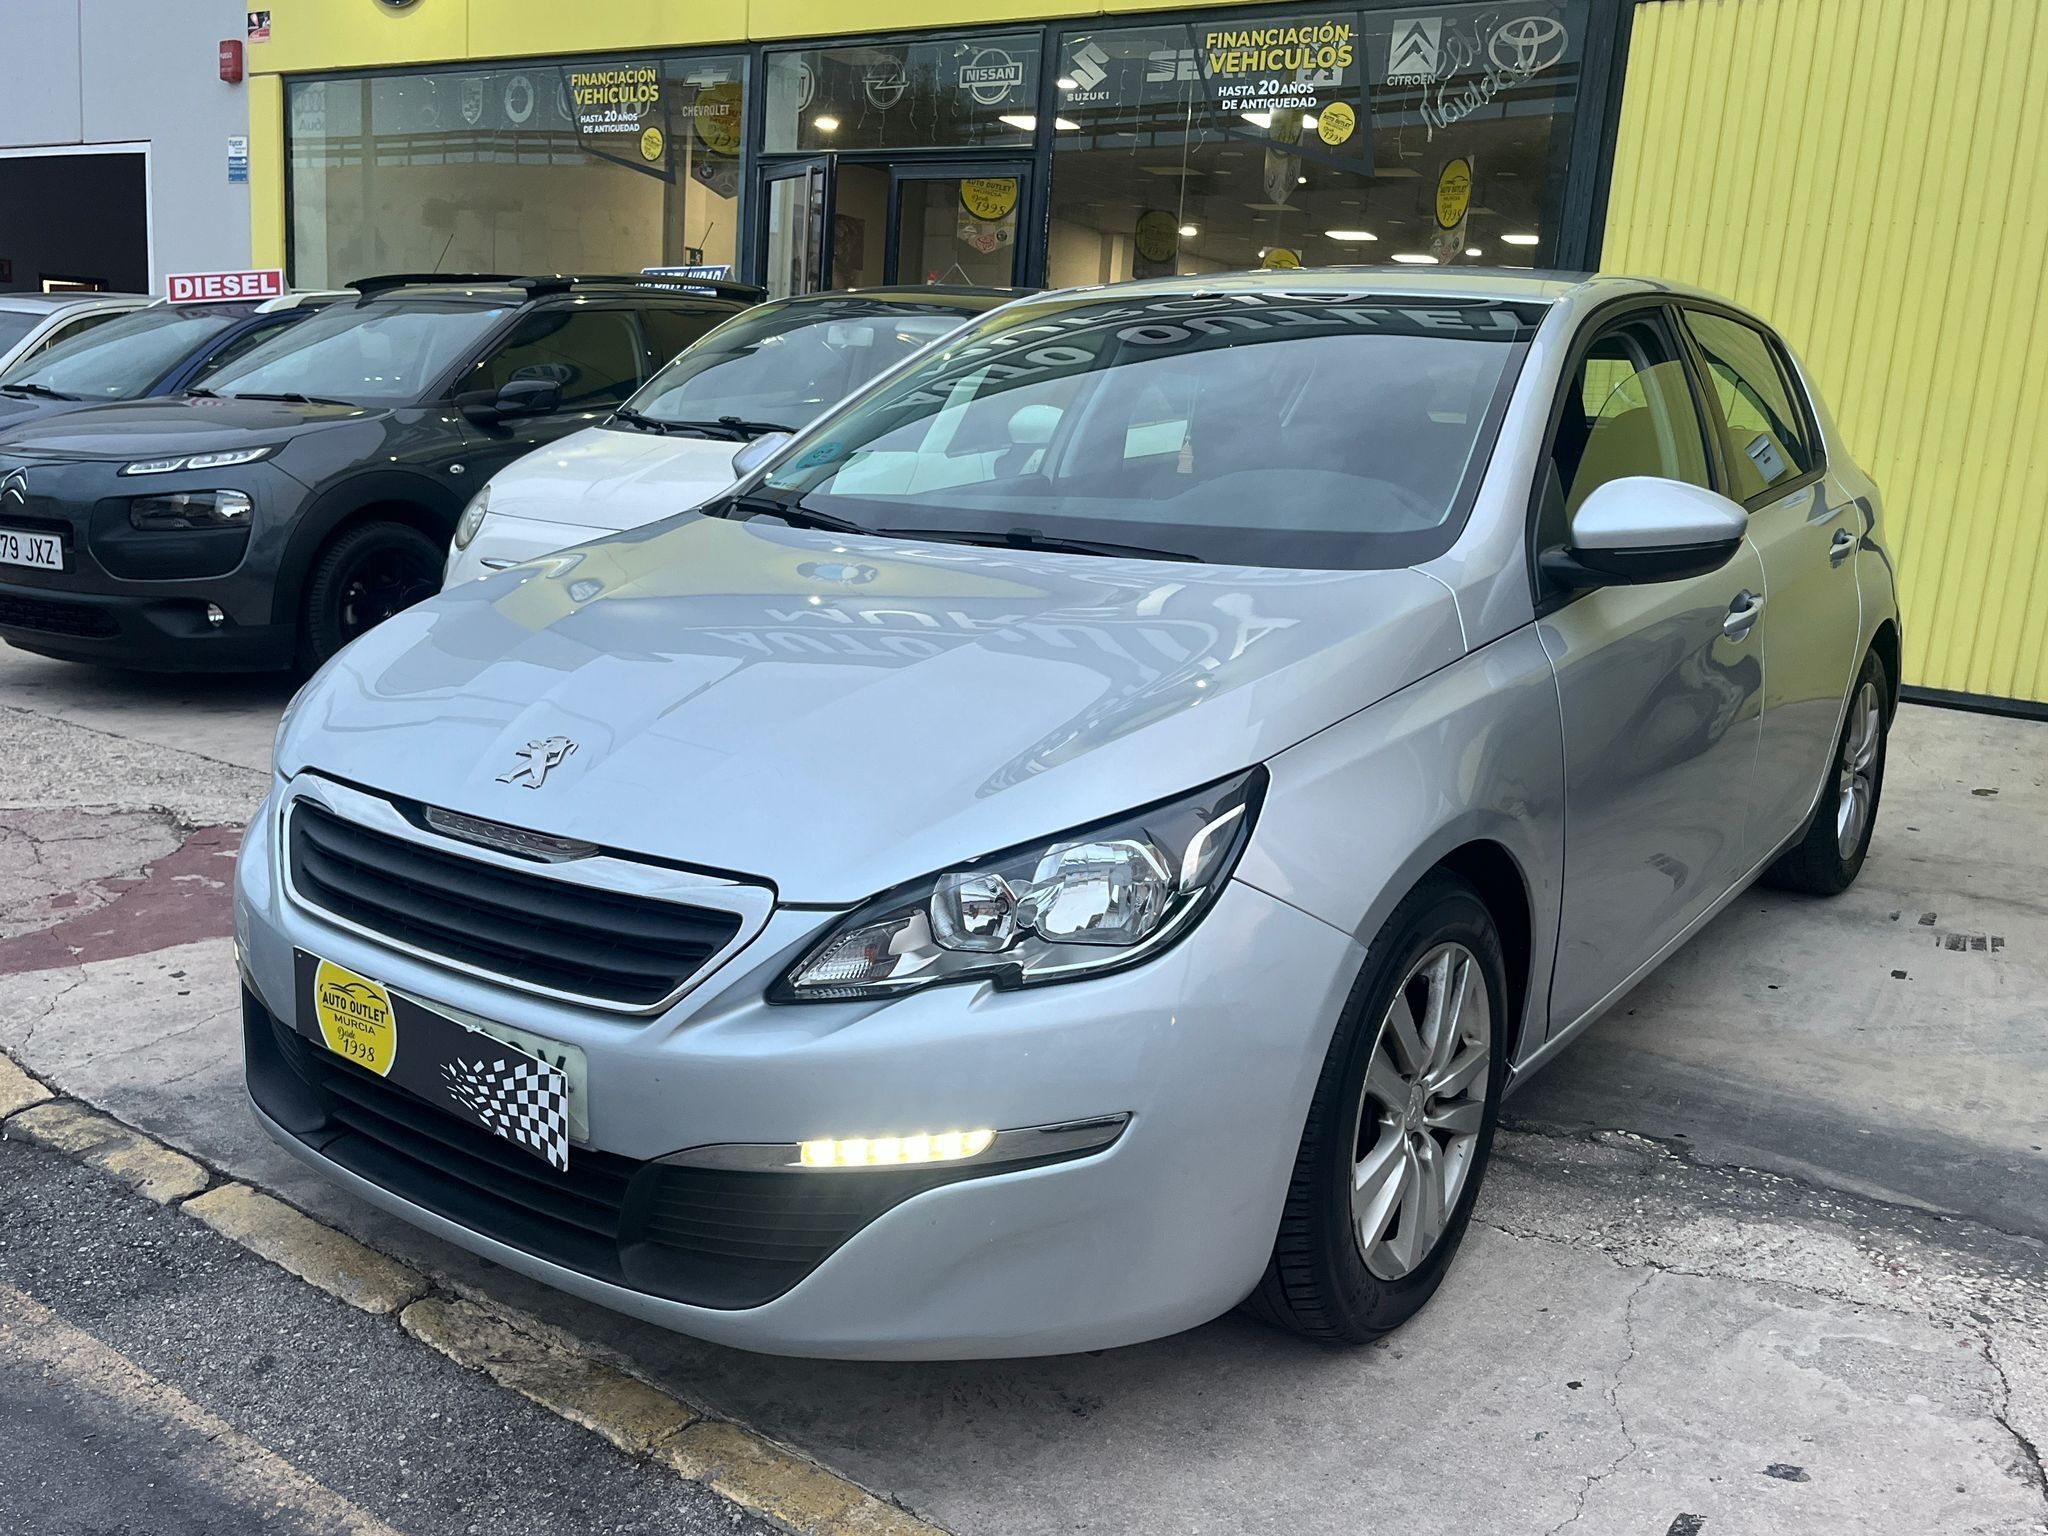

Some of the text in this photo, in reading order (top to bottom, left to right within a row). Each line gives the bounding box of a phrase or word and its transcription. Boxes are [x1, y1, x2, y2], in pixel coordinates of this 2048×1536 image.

[1206, 21, 1350, 49] FINANCIACIÓN
[1209, 44, 1353, 74] VEHÍCULOS
[571, 67, 657, 87] FINANCIACIÓN
[966, 66, 1015, 81] NISSAN
[574, 83, 660, 105] VEHÍCULOS
[1066, 91, 1110, 102] SUZUKI
[1218, 79, 1314, 97] HASTA 20 AÑOS
[682, 104, 730, 117] CHEVROLET
[1222, 97, 1317, 110] DE ANTIGUEDAD
[580, 110, 638, 123] HASTA 20 AÑOS
[583, 123, 640, 134] DE ANTIGUEDAD
[986, 182, 1012, 192] OUTLET
[975, 200, 1007, 216] 1998
[174, 273, 277, 299] DIESEL
[26, 537, 56, 565] JXZ
[441, 814, 544, 849] PEUGEOT
[323, 991, 386, 1024] AUTO OUTLET
[334, 1013, 376, 1036] MURCIA
[343, 1038, 375, 1062] 1998
